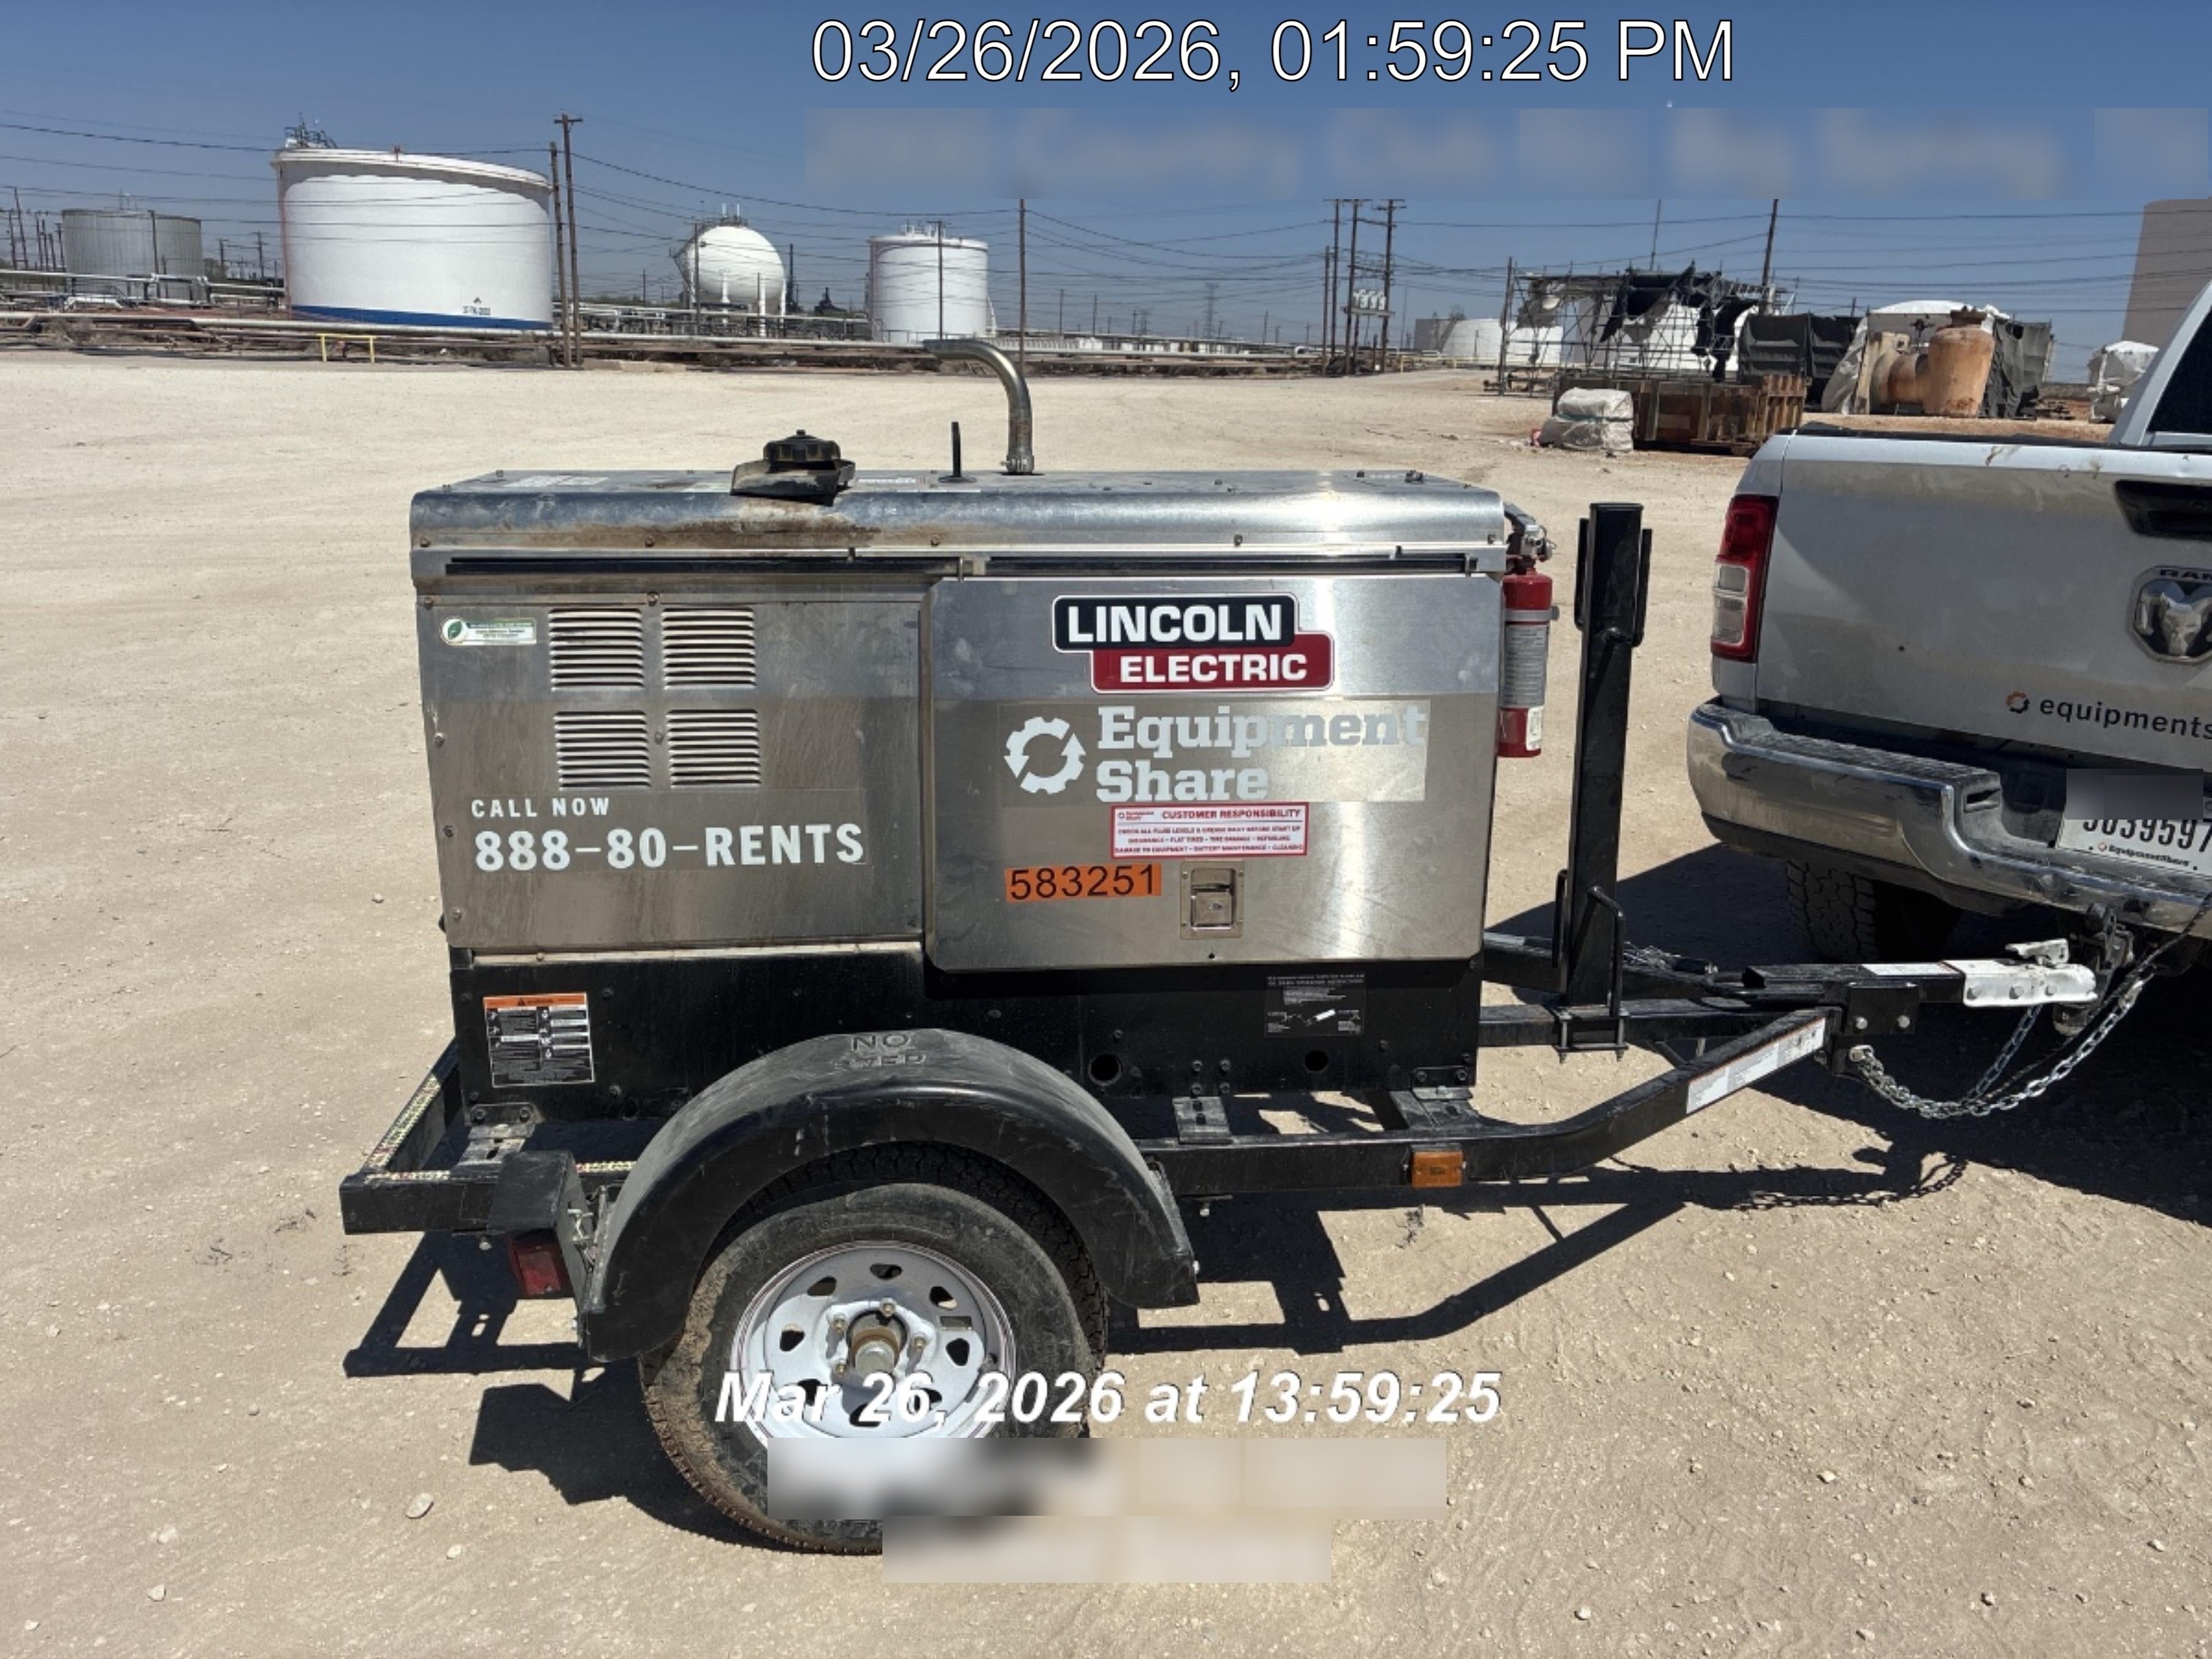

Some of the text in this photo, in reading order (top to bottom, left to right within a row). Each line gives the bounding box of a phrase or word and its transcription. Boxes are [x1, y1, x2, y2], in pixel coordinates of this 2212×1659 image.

[1068, 605, 1282, 643] LINCOLN
[1120, 654, 1308, 683] ELECTRIC
[1098, 705, 1428, 758] Equipment
[1096, 759, 1269, 802] Share
[471, 797, 610, 818] CALL NOW
[1161, 810, 1217, 820] CUSTOMER
[1220, 808, 1301, 818] RESPONSIBILITY
[475, 823, 863, 871] 888-80-RENTS
[1010, 863, 1156, 900] 583251
[852, 1033, 911, 1051] NO
